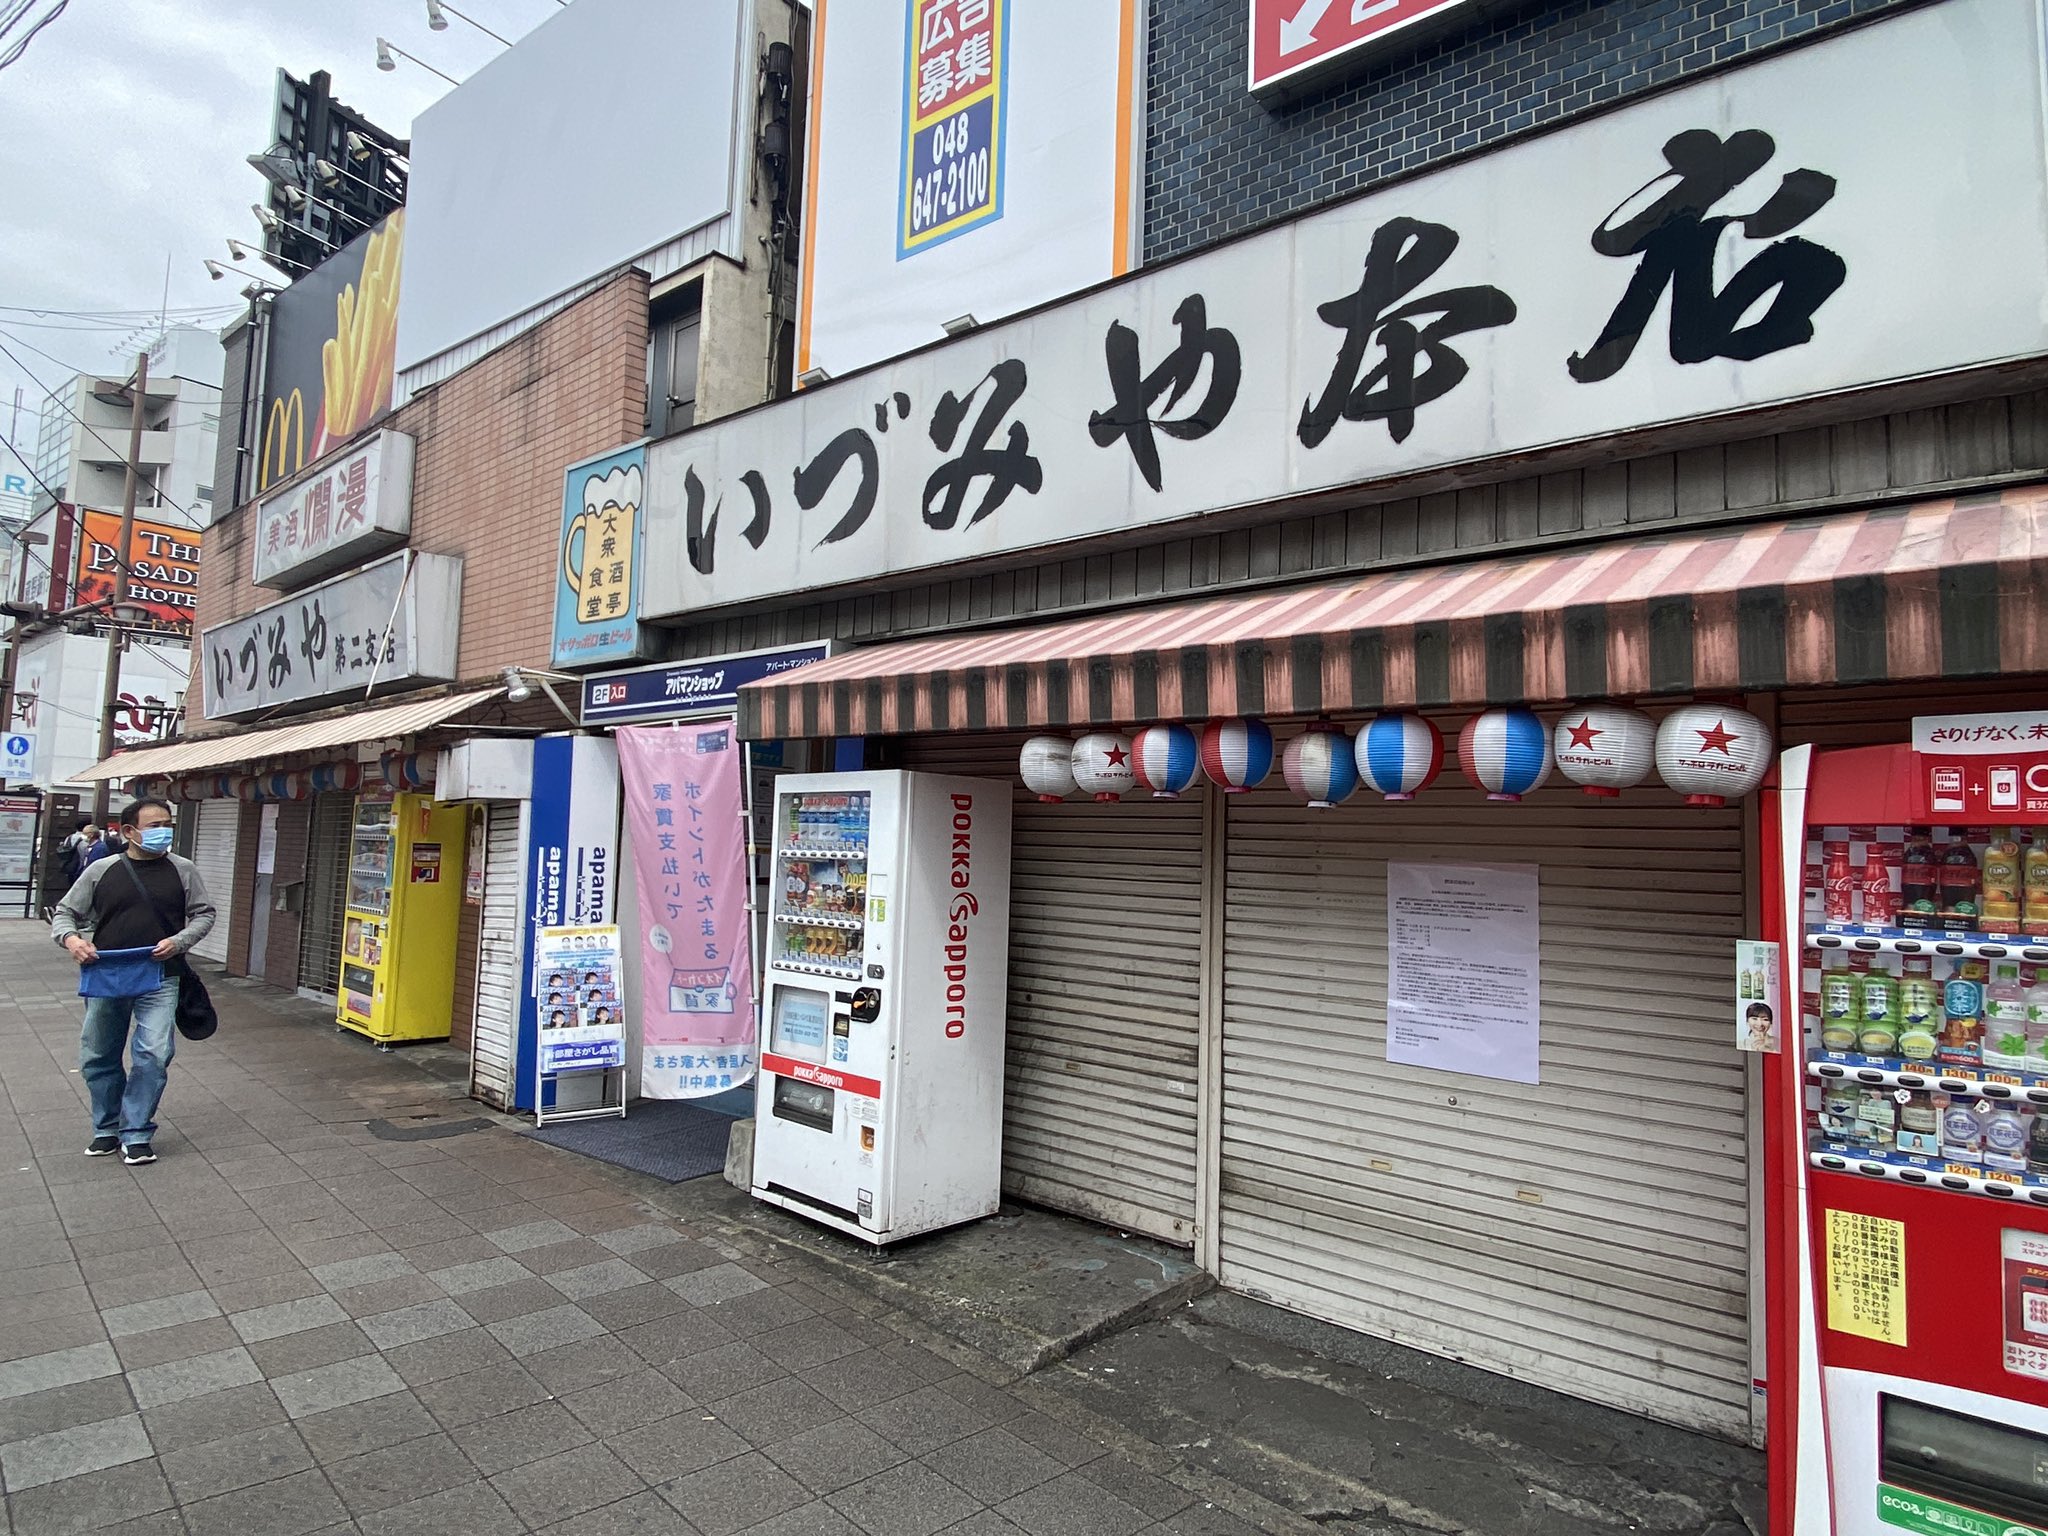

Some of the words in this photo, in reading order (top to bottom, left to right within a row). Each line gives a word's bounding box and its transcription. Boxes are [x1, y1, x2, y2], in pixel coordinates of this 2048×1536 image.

[919, 31, 991, 109] 募集
[932, 112, 969, 164] 048
[685, 129, 1846, 574] いづみや本店
[602, 513, 618, 558] 大衆
[586, 567, 603, 618] 食堂
[606, 561, 624, 614] 酒亭
[214, 598, 327, 699] いづみや
[665, 670, 725, 696] アパマンショップ
[1944, 1068, 1976, 1080] 130円
[1948, 1164, 1978, 1176] 120円
